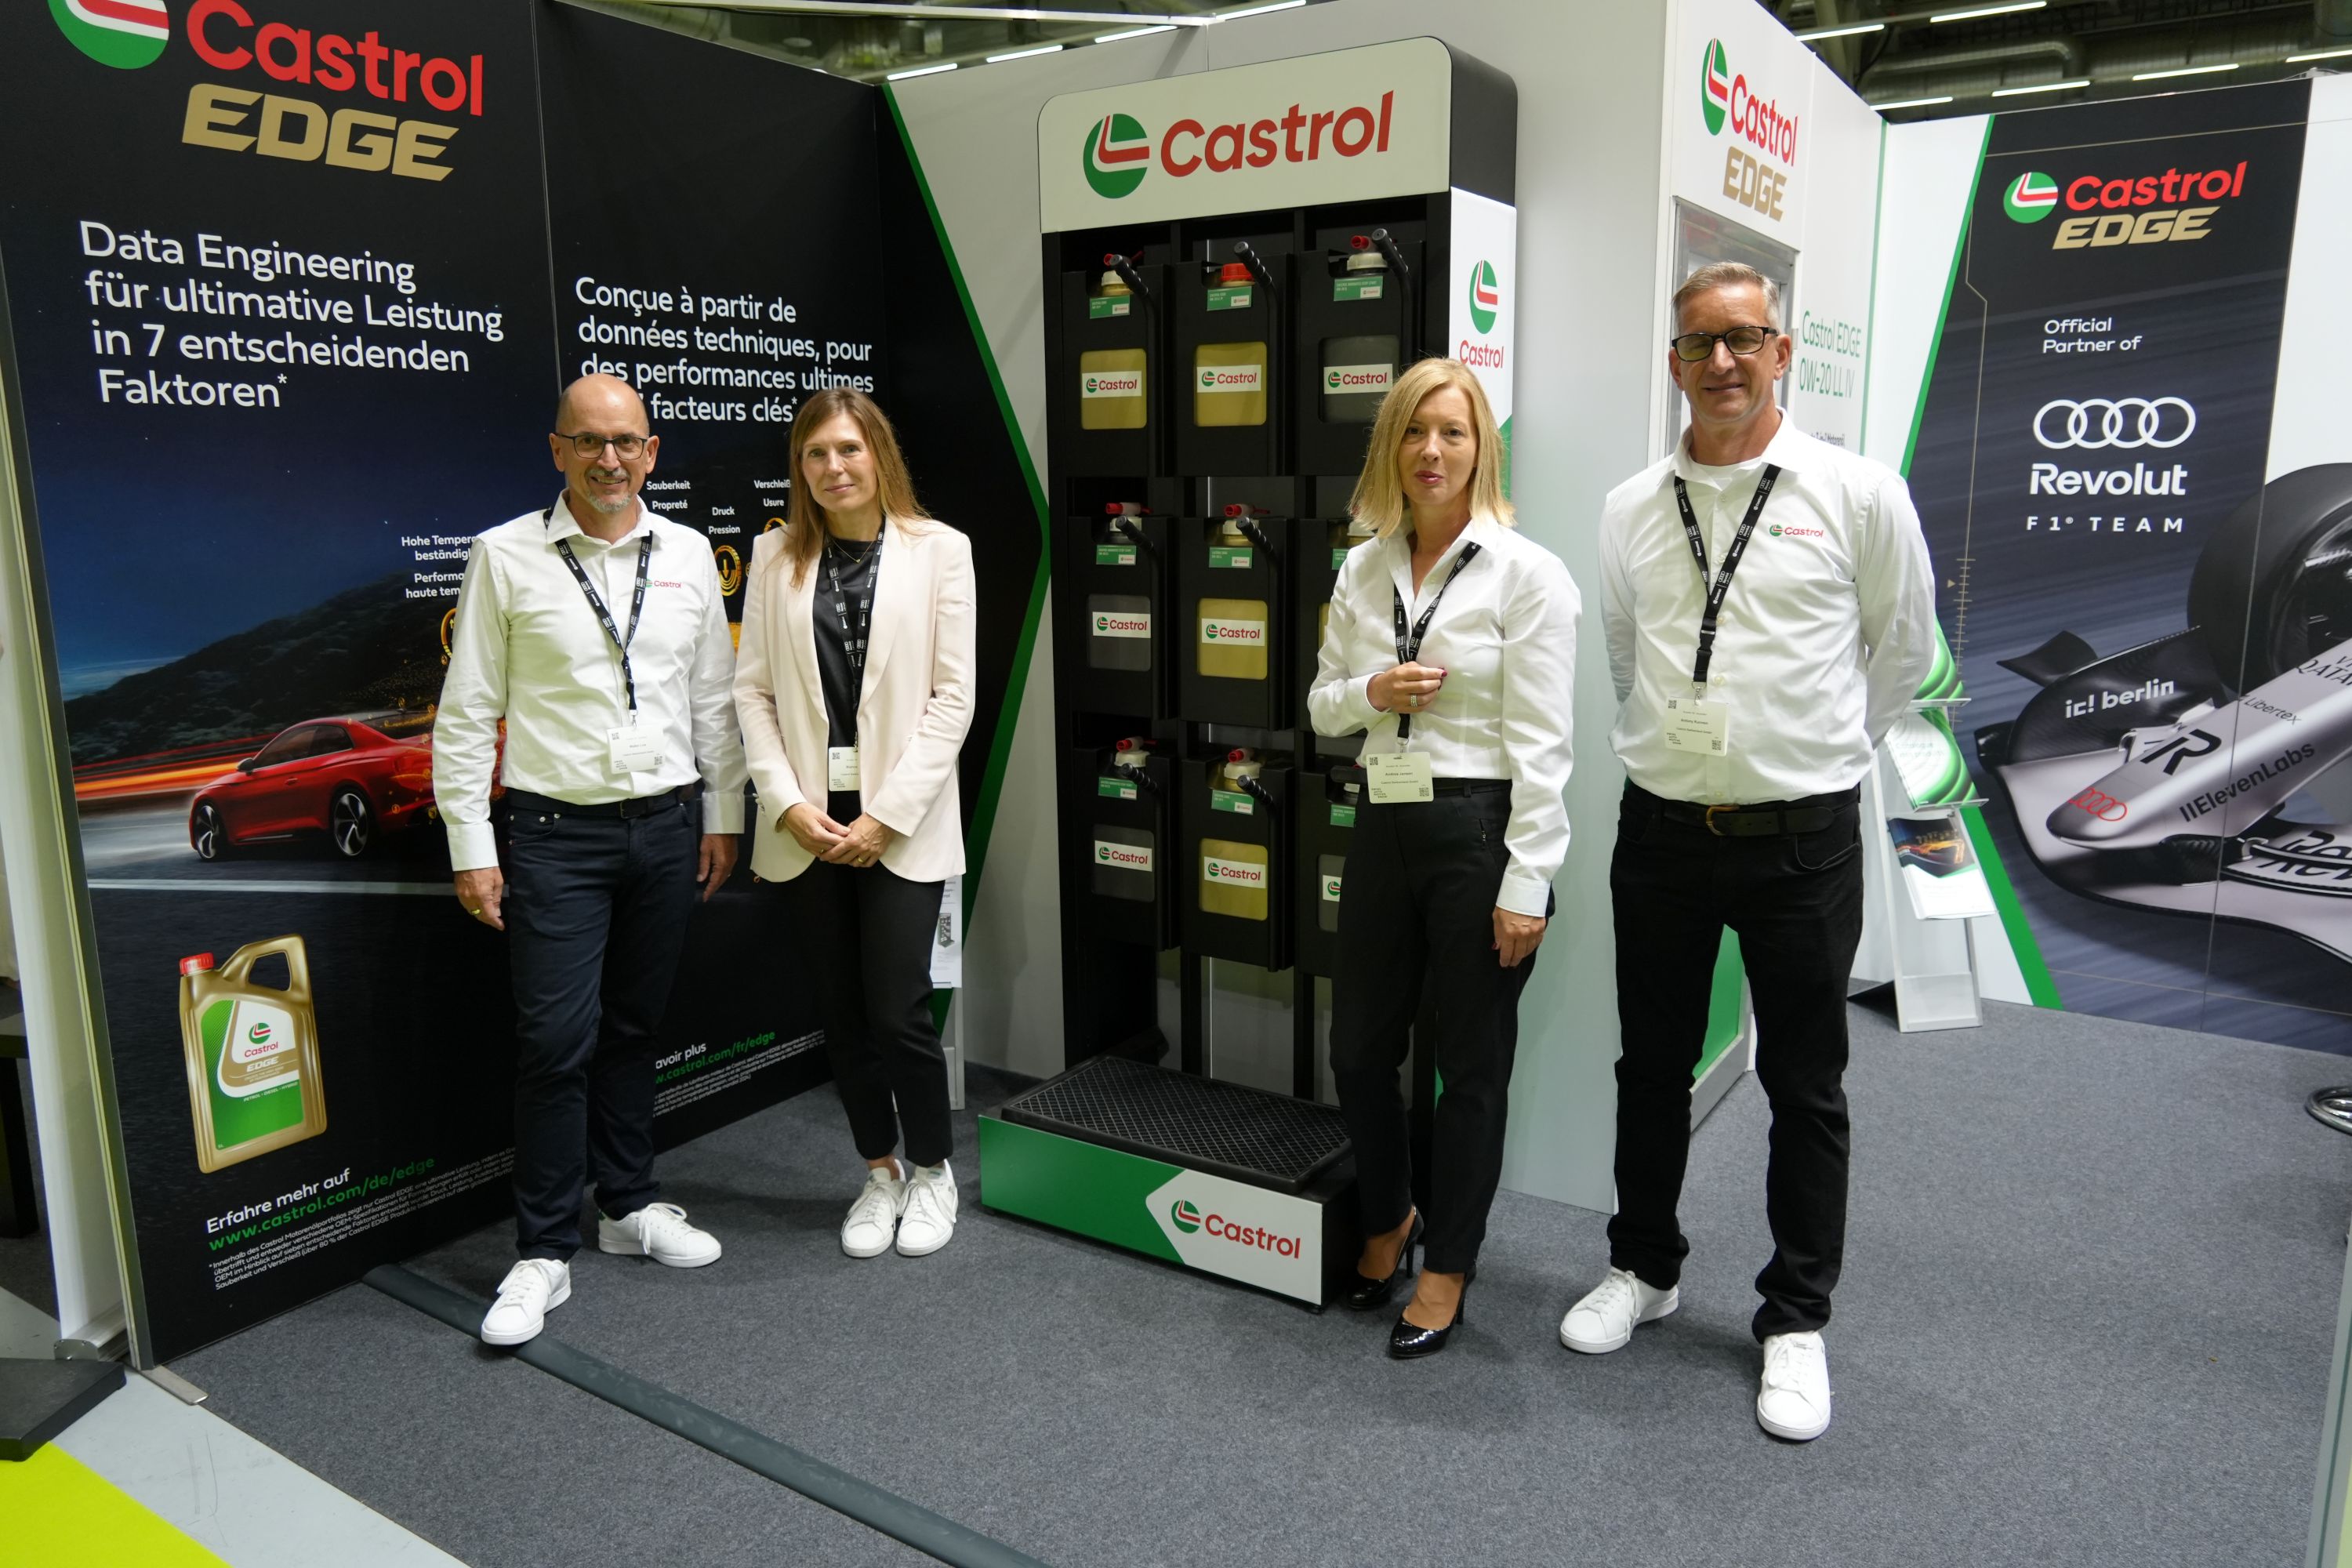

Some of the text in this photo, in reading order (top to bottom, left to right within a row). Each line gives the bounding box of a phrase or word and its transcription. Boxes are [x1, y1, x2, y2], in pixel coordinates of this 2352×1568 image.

[187, 0, 483, 116] Castrol
[181, 83, 460, 181] EDGE
[1160, 89, 1395, 178] Castrol
[1730, 73, 1798, 167] Castrol
[1723, 145, 1788, 222] EDGE
[2065, 161, 2249, 211] Castrol
[2052, 205, 2221, 249] EDGE
[80, 220, 416, 294] Data Engineering
[85, 270, 504, 342] für ultimative Leistung
[575, 277, 797, 324] Conçue à partir de
[578, 315, 872, 366] données techniques, pour
[1802, 310, 1862, 358] Castrol EDGE
[2044, 318, 2112, 335] Official
[93, 320, 470, 372] in 7 entscheidenden
[1460, 339, 1504, 368] Castrol
[2042, 336, 2143, 354] Partner of
[581, 354, 874, 394] des performances ultimes
[1098, 379, 1138, 391] Castrol
[1217, 372, 1258, 385] Castrol
[1342, 372, 1388, 386] Castrol
[650, 393, 747, 422] facteurs
[647, 480, 691, 491] Sauberkeit
[2029, 463, 2188, 496] Revolut
[652, 499, 688, 511] Propreté
[712, 506, 735, 517] Druck
[763, 499, 785, 507] Usure
[708, 525, 741, 535] Pression
[1784, 527, 1824, 539] Castrol
[2089, 517, 2183, 533] TEAM
[401, 536, 430, 547] Hohe
[405, 588, 437, 599] haute
[654, 580, 681, 589] Castrol
[1109, 619, 1147, 631] Castrol
[1219, 626, 1261, 639] Castrol
[2297, 659, 2352, 686] QATA
[2102, 678, 2175, 711] berlin
[2244, 696, 2303, 726] Libertex
[1112, 851, 1148, 865] Castrol
[1221, 866, 1261, 881] Castrol
[244, 1041, 278, 1058] Castrol
[655, 1043, 707, 1069] avoir plus
[246, 1056, 279, 1073] EDGE
[206, 1167, 350, 1233] Erfahre mehr auf
[209, 1159, 434, 1251] www.castrol.com/de/edge
[214, 1259, 246, 1276] übertrifft
[246, 1253, 260, 1262] und
[260, 1241, 292, 1258] entweder
[292, 1224, 335, 1244] verschiedene
[398, 1193, 408, 1204] für
[247, 1247, 260, 1255] des
[260, 1236, 284, 1250] Castrol
[285, 1212, 347, 1240] Motorenölportfolios
[375, 1192, 396, 1205] Castrol
[396, 1185, 414, 1196] EDGE
[215, 1270, 234, 1283] OEM
[234, 1267, 244, 1276] im
[244, 1255, 270, 1271] Hinblick
[271, 1250, 284, 1261] auf
[284, 1242, 306, 1255] sieben
[306, 1222, 352, 1247] entscheidende
[352, 1213, 379, 1228] Faktoren
[1205, 1214, 1301, 1259] Castrol
[216, 1272, 253, 1290] Sauberkeit
[253, 1265, 267, 1276] und
[267, 1251, 302, 1269] Verschleiß
[301, 1244, 319, 1257] (über
[336, 1232, 348, 1241] der
[348, 1223, 371, 1236] Castrol
[371, 1215, 390, 1229] EDGE
